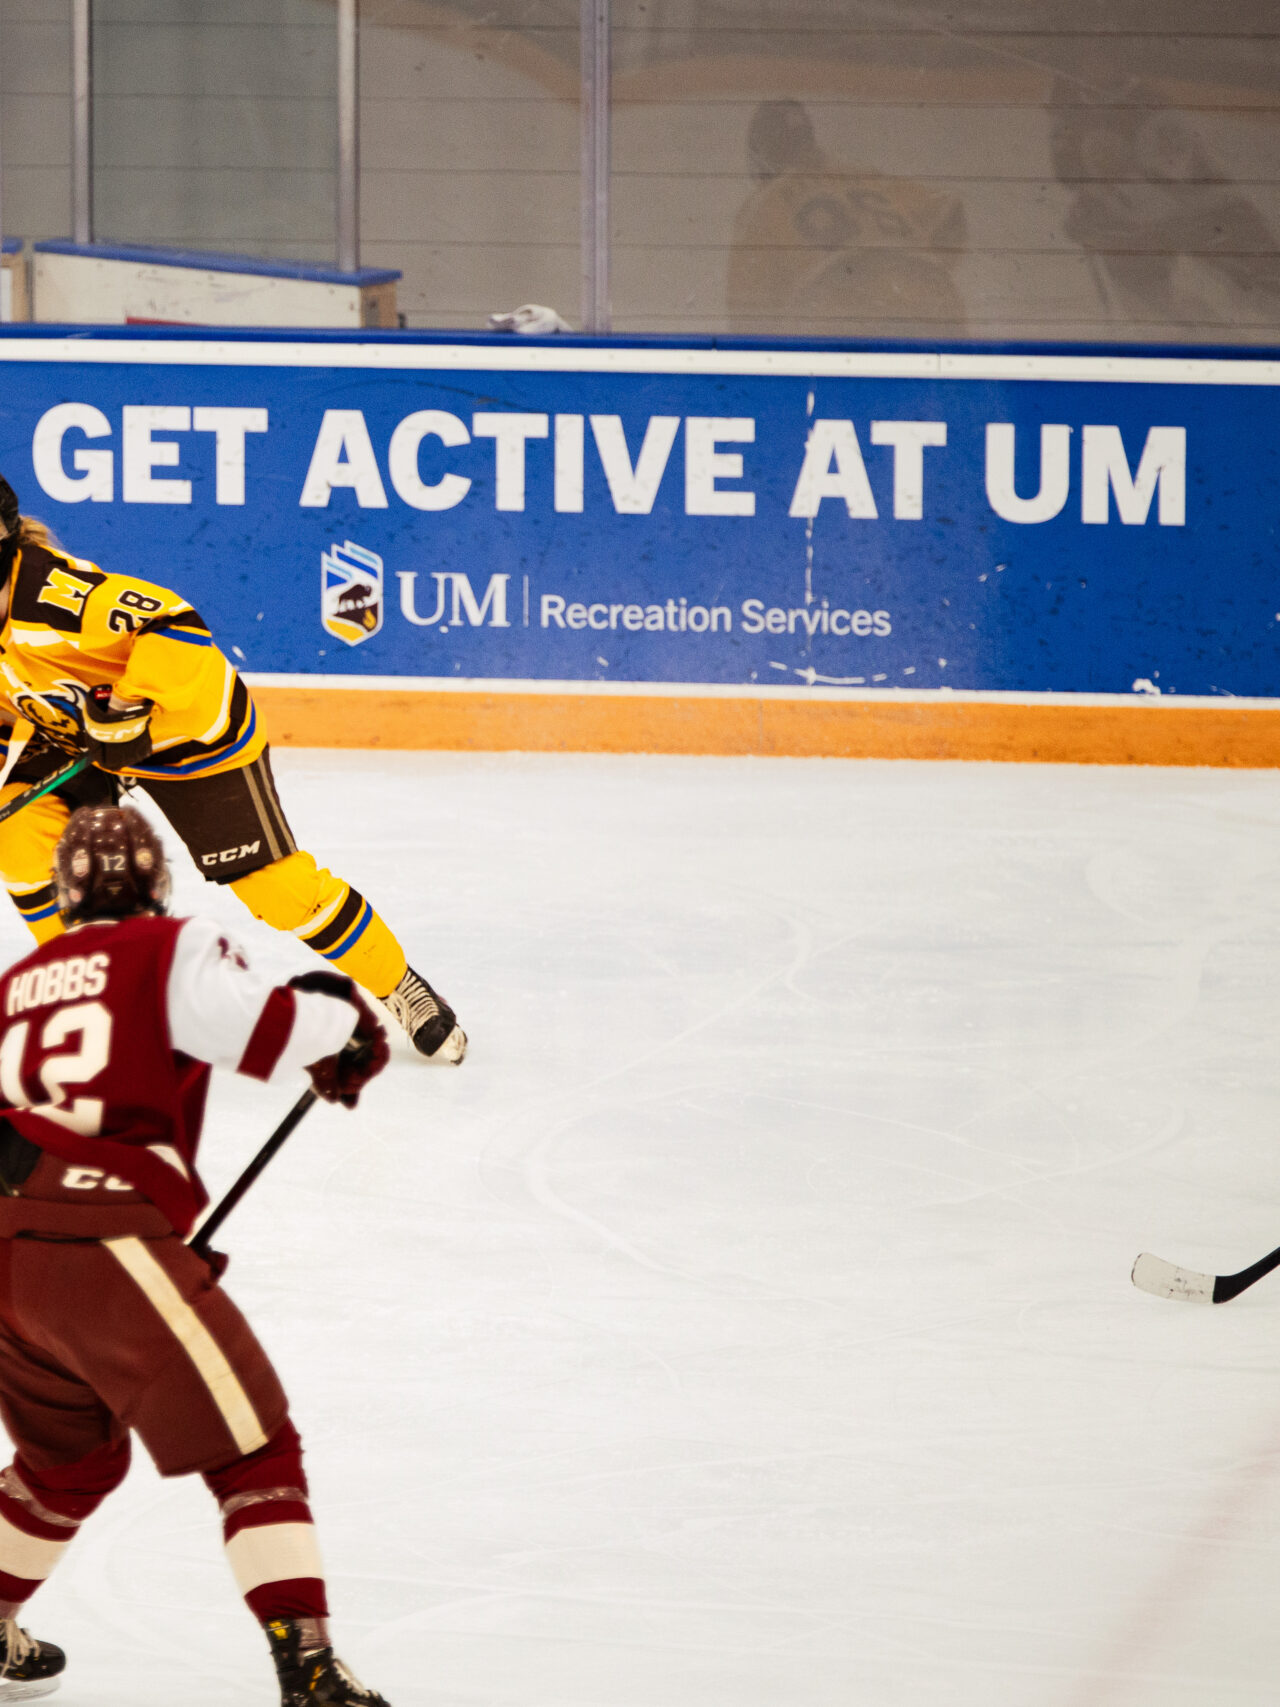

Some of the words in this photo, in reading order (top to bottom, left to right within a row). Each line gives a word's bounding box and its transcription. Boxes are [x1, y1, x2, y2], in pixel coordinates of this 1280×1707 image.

[32, 402, 269, 506] GET
[299, 408, 756, 517] ACTIVE
[788, 419, 948, 520] AT
[985, 422, 1187, 526] UM
[37, 568, 95, 617] M
[108, 589, 164, 634] 28
[396, 571, 511, 627] UM
[540, 594, 732, 632] Recreation
[741, 599, 892, 637] Services
[102, 855, 126, 871] 12
[201, 840, 261, 866] CCM
[6, 952, 111, 1016] HOBBS
